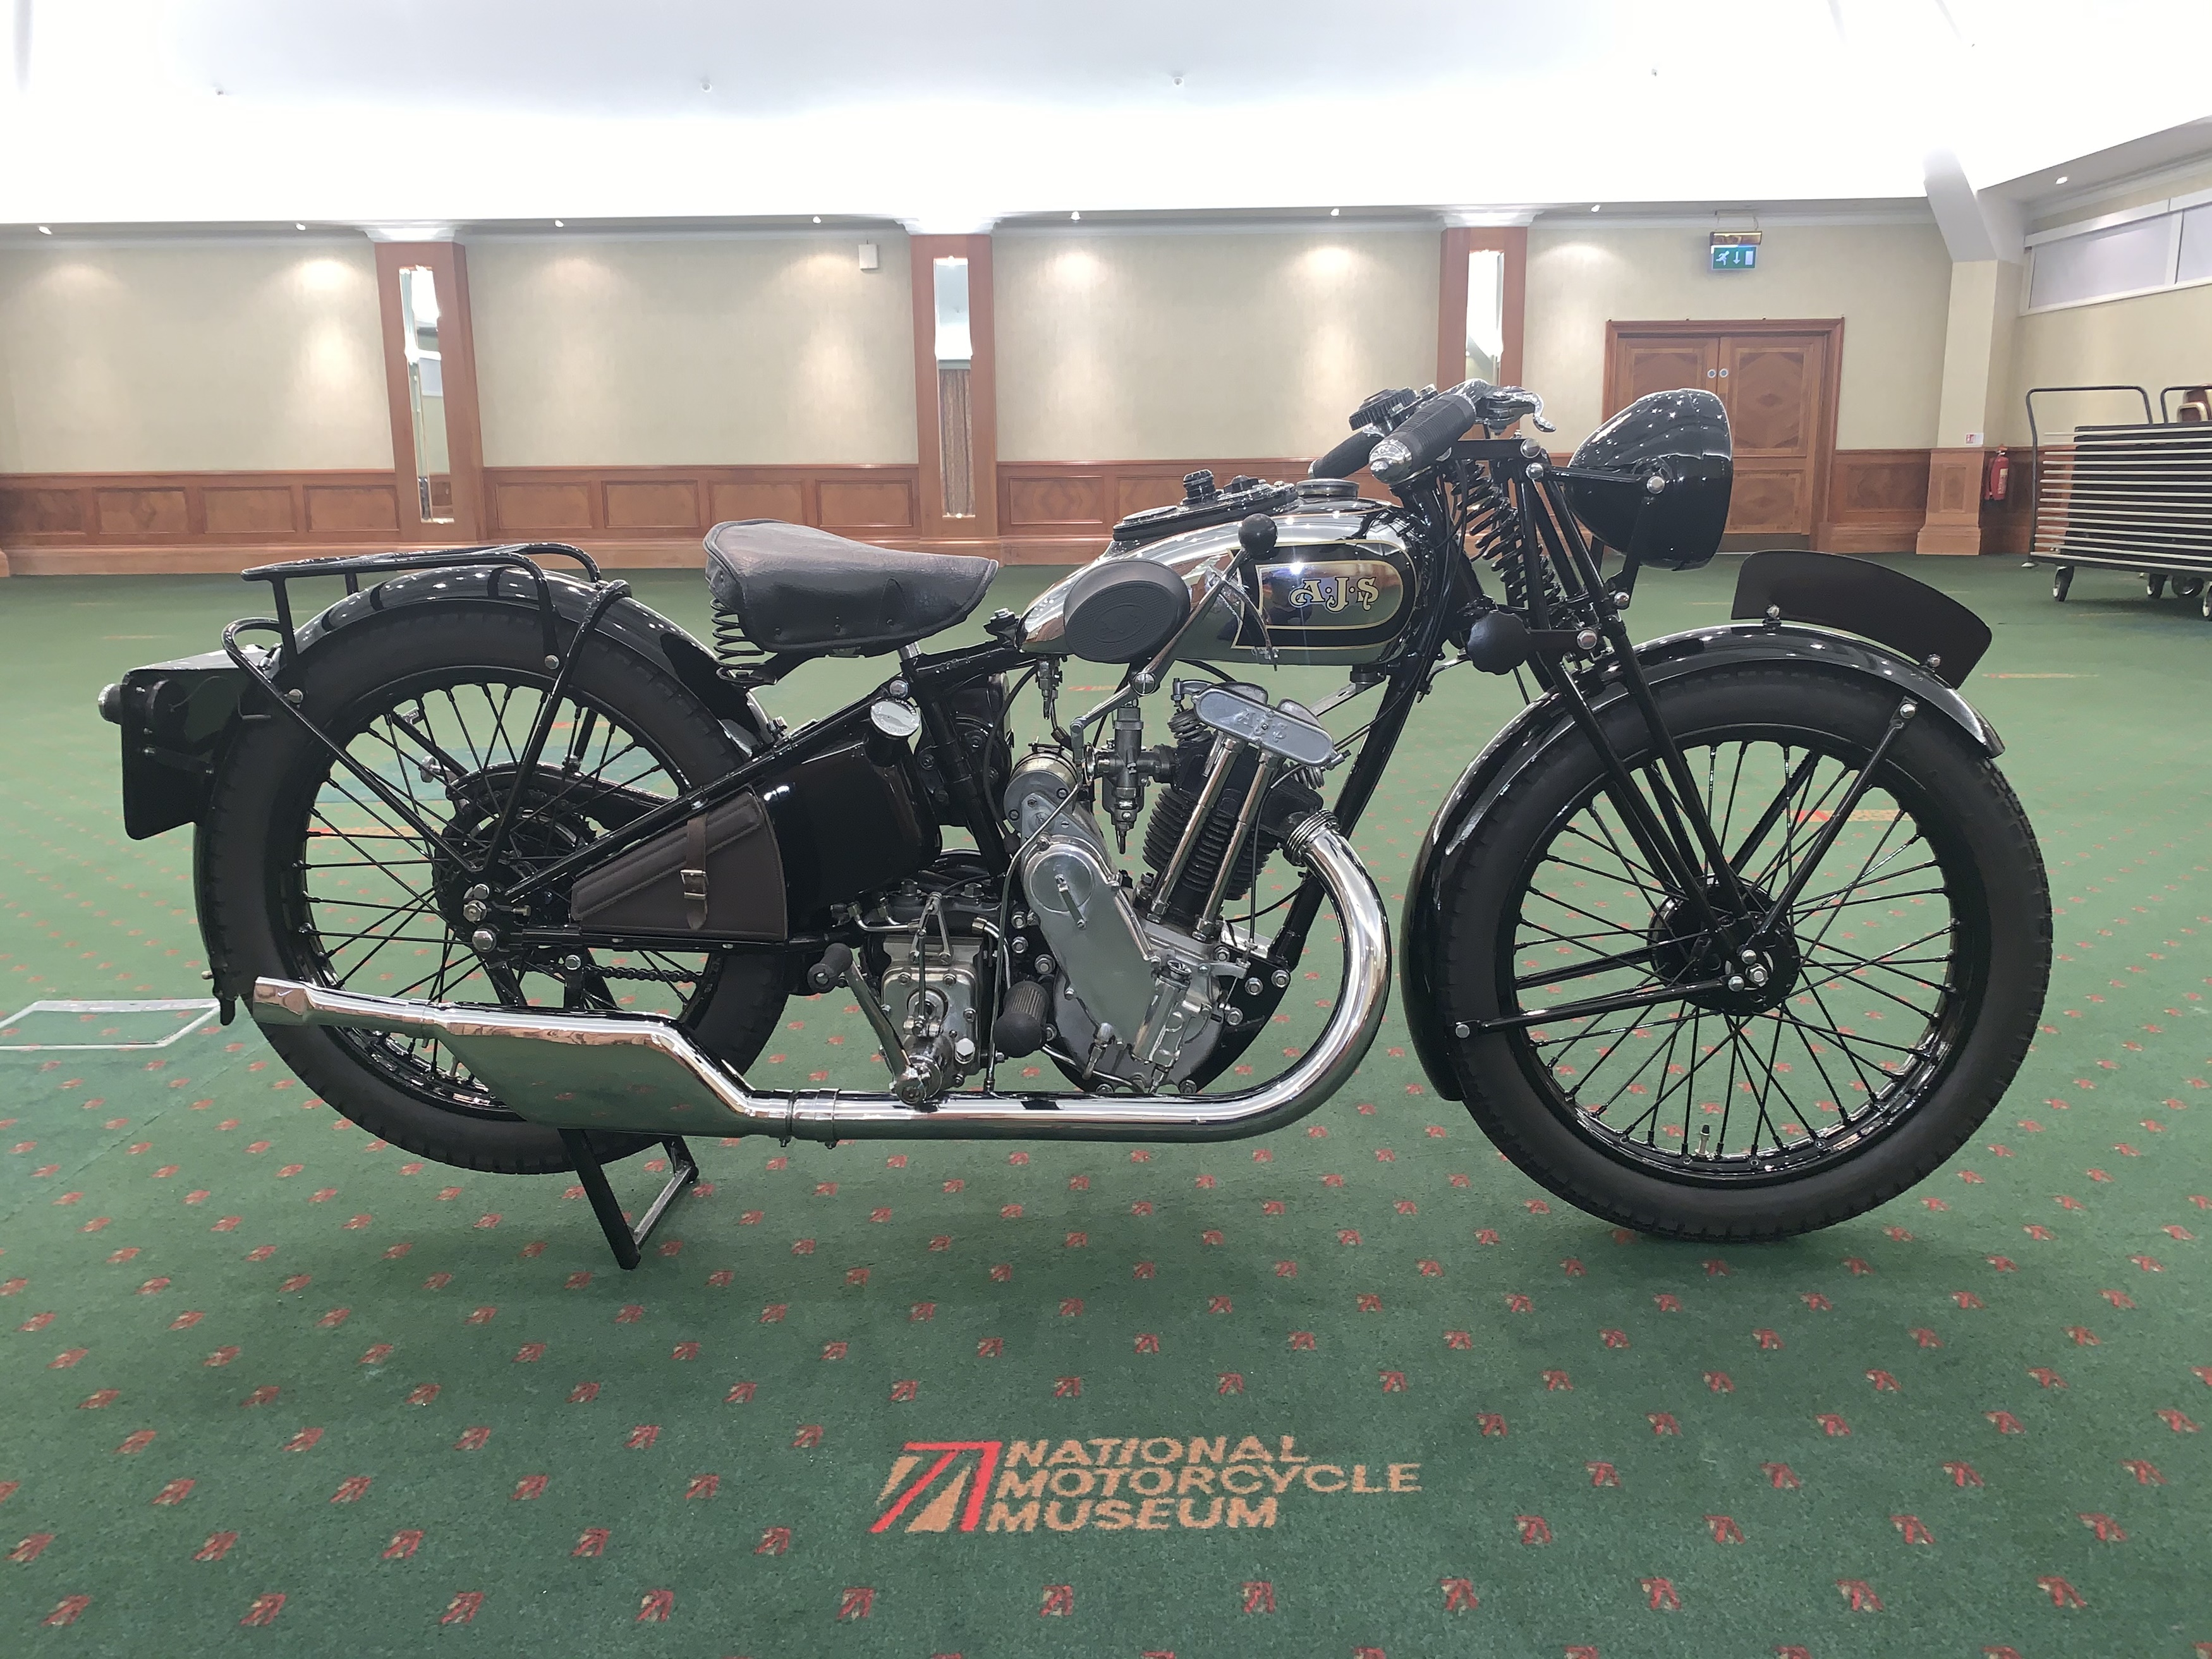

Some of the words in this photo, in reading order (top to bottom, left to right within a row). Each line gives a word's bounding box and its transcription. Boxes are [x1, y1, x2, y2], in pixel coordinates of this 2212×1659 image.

[1005, 1435, 1310, 1468] NATIONAL
[997, 1464, 1421, 1500] MOTORCYCLE
[985, 1497, 1278, 1533] MUSEUM
